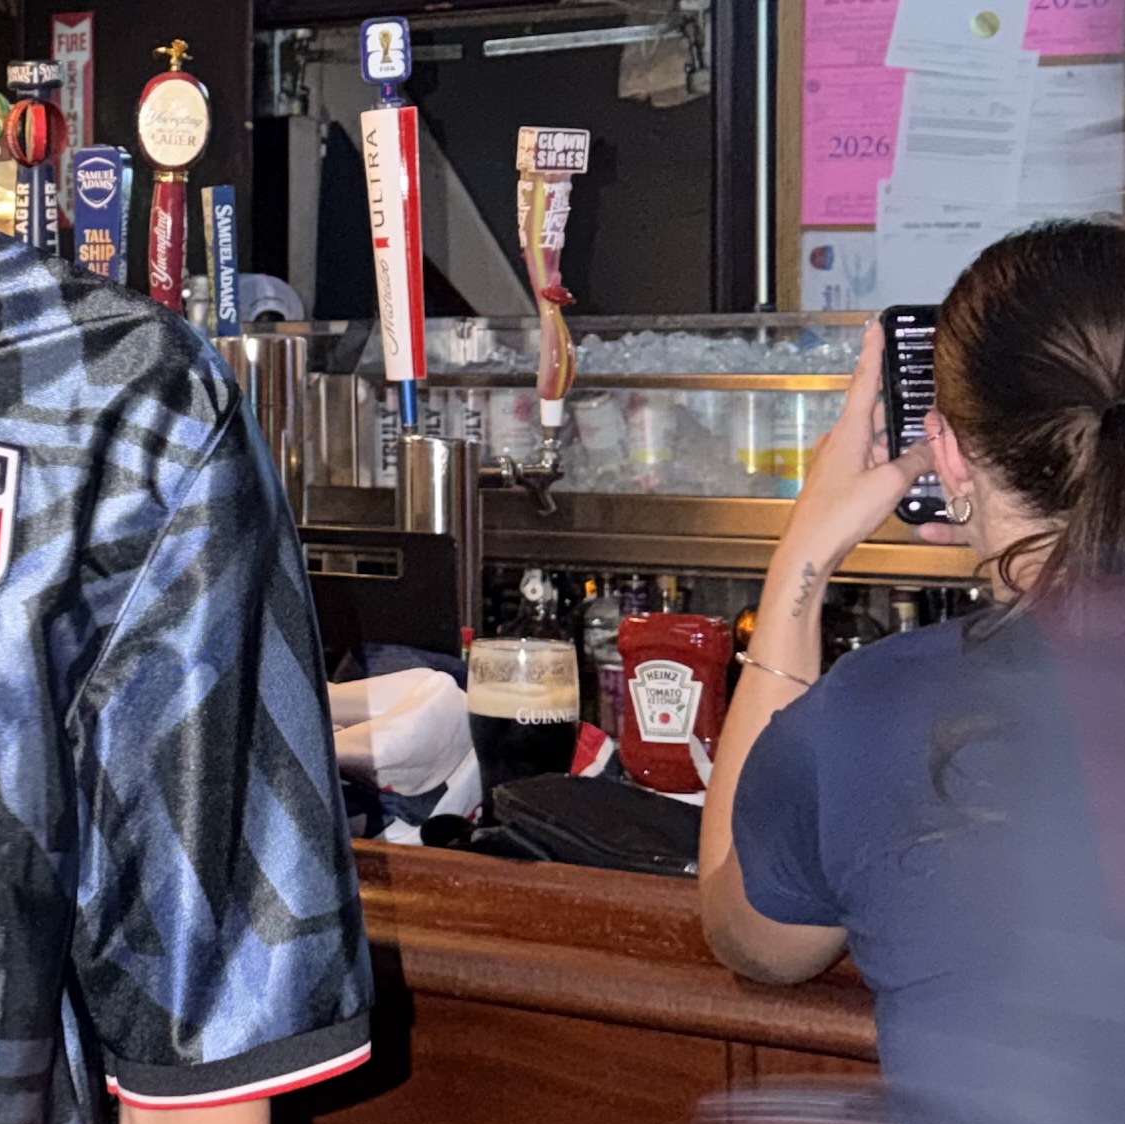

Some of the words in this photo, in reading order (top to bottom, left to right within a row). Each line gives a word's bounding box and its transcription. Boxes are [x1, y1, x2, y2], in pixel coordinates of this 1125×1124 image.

[56, 32, 87, 52] FIRE
[379, 65, 396, 73] FIFA
[538, 133, 586, 152] CLOWN
[828, 135, 891, 158] 2026
[537, 150, 585, 167] SHOES
[77, 168, 117, 182] SAMUEL
[365, 128, 386, 229] ULTRA
[80, 179, 115, 191] ADAMS
[44, 183, 59, 246] LAGER
[83, 229, 112, 243] TALL
[215, 204, 234, 264] SAMUEL
[79, 244, 116, 262] SHIP
[150, 206, 173, 291] Yuengling
[87, 262, 110, 276] ALE
[219, 265, 237, 323] ADAMS
[381, 407, 397, 471] TRULY
[646, 670, 679, 682] HEINZ
[646, 687, 683, 698] TOMATO
[516, 707, 575, 726] GUINNE
